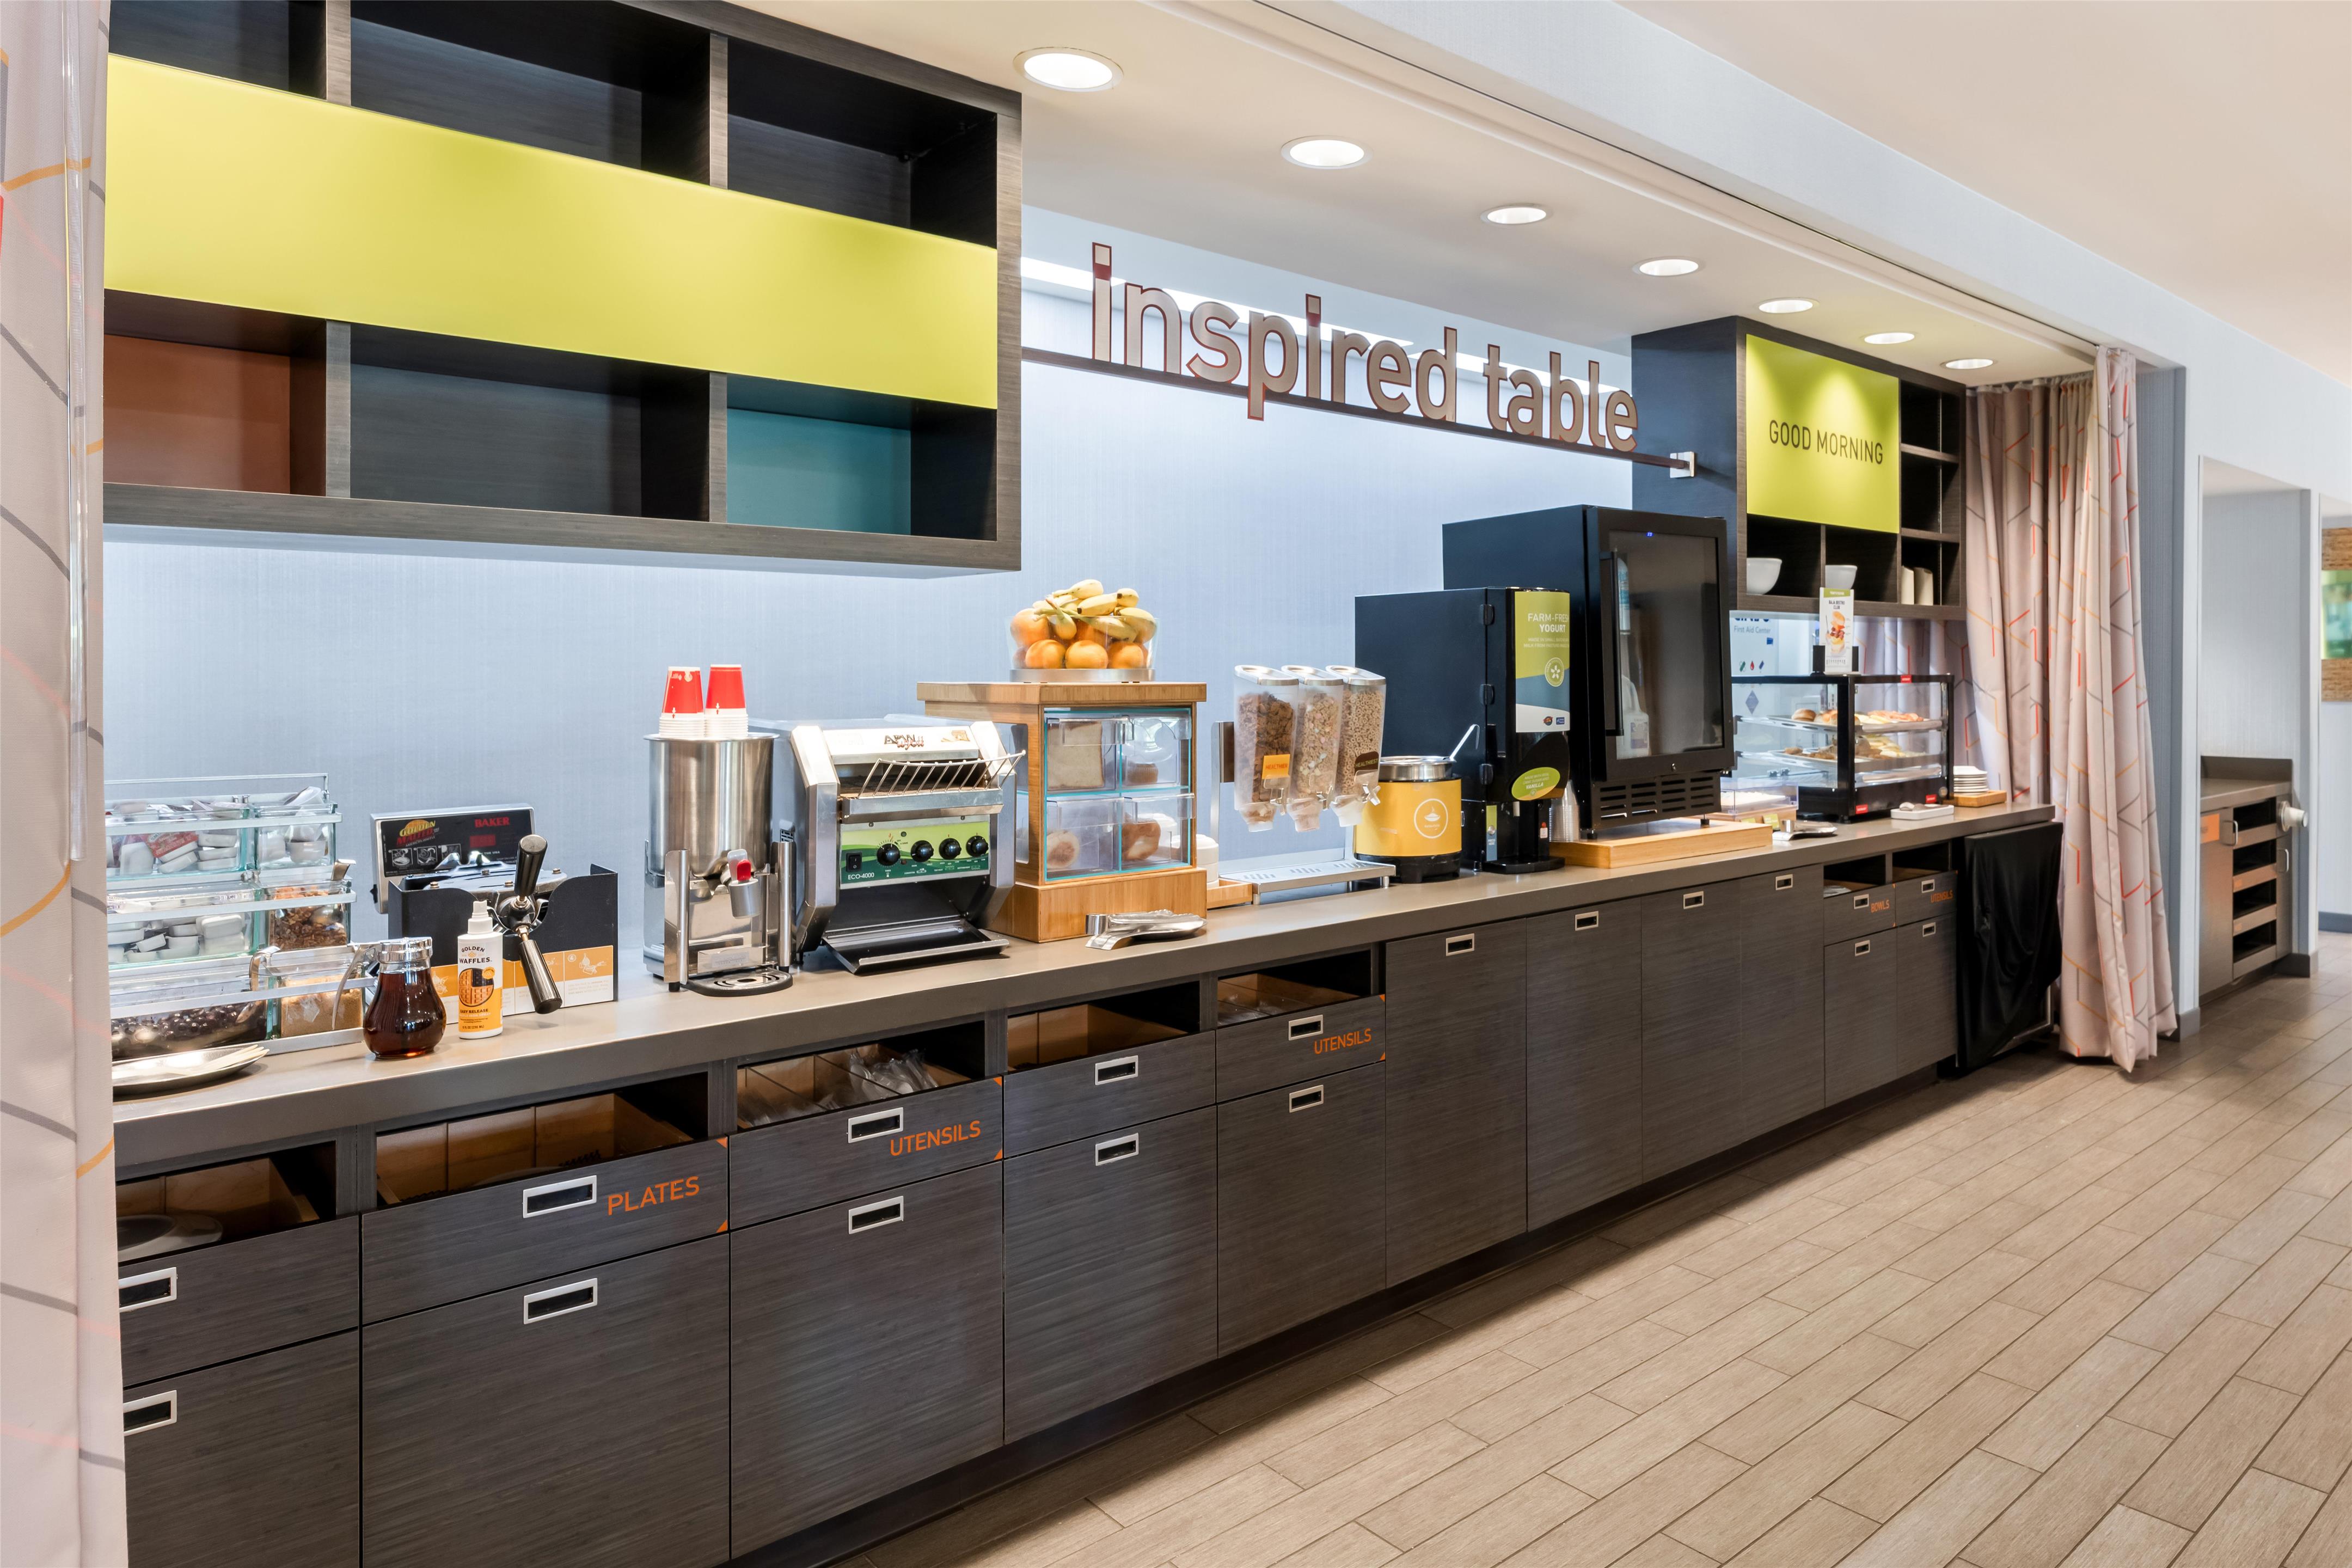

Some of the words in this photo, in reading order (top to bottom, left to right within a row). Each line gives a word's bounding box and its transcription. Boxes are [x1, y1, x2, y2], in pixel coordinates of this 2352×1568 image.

[1092, 242, 1457, 421] inspired
[1483, 344, 1638, 452] table
[1769, 420, 1811, 450] GOOD
[1817, 430, 1883, 464] MORNING
[1540, 624, 1566, 633] YOGURT
[1734, 625, 1744, 633] First
[1355, 758, 1378, 768] HEALTHIEST
[399, 820, 436, 837] GOLDEN
[475, 817, 510, 828] BAKER
[396, 828, 434, 846] MALTED
[1931, 890, 1953, 903] UTENSILS
[1871, 899, 1890, 913] BOWLS
[1314, 1028, 1371, 1055] UTENSILS
[890, 1120, 981, 1156] UTENSILS
[608, 1175, 700, 1216] PLATES
